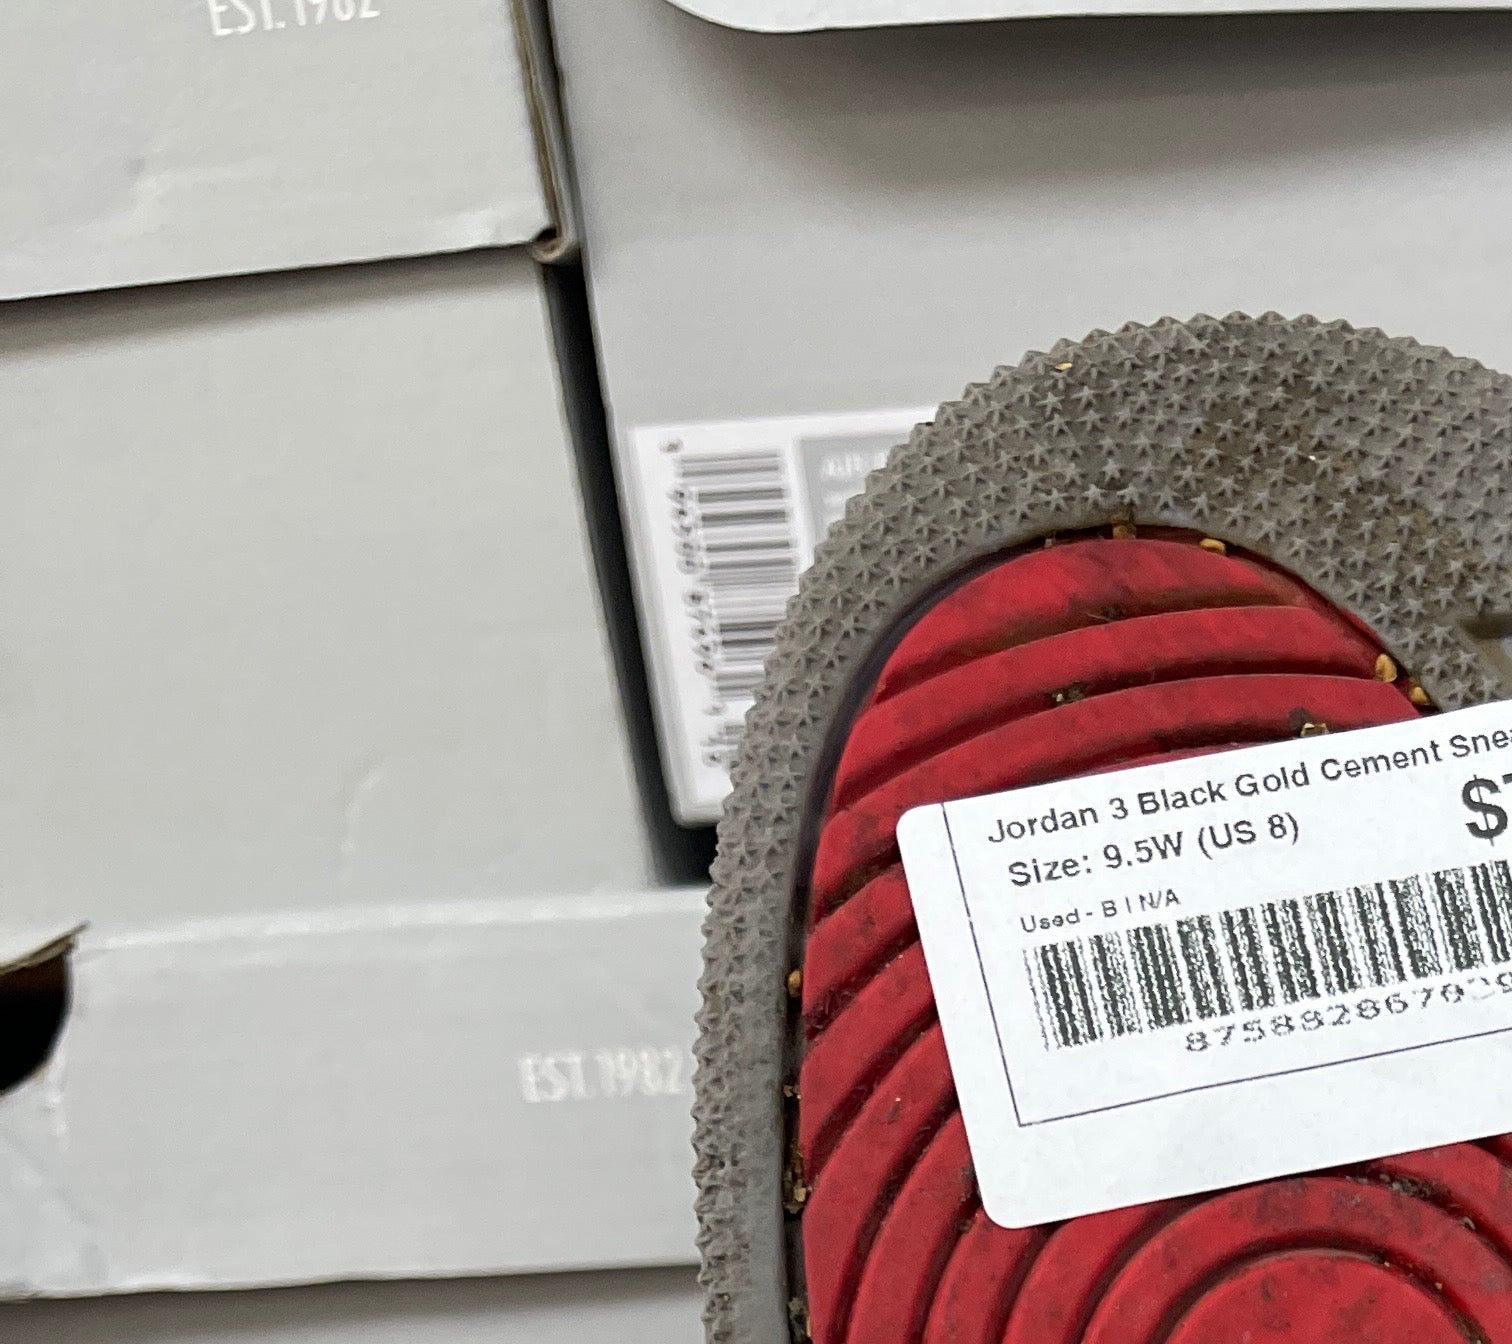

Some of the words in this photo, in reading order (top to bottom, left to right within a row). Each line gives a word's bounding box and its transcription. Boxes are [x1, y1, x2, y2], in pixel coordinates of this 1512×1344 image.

[988, 803, 1099, 845] Jordan
[1109, 795, 1131, 822] 3
[1139, 780, 1226, 816] Black
[1234, 762, 1310, 798] Gold
[1320, 738, 1442, 781] Cement
[1008, 853, 1092, 888] Size:
[1103, 831, 1184, 870] 9.5W
[1197, 820, 1258, 860] (US
[1267, 812, 1300, 845] 8)
[1019, 908, 1081, 934] Used
[1101, 899, 1118, 918] B
[1138, 887, 1181, 913] N/A
